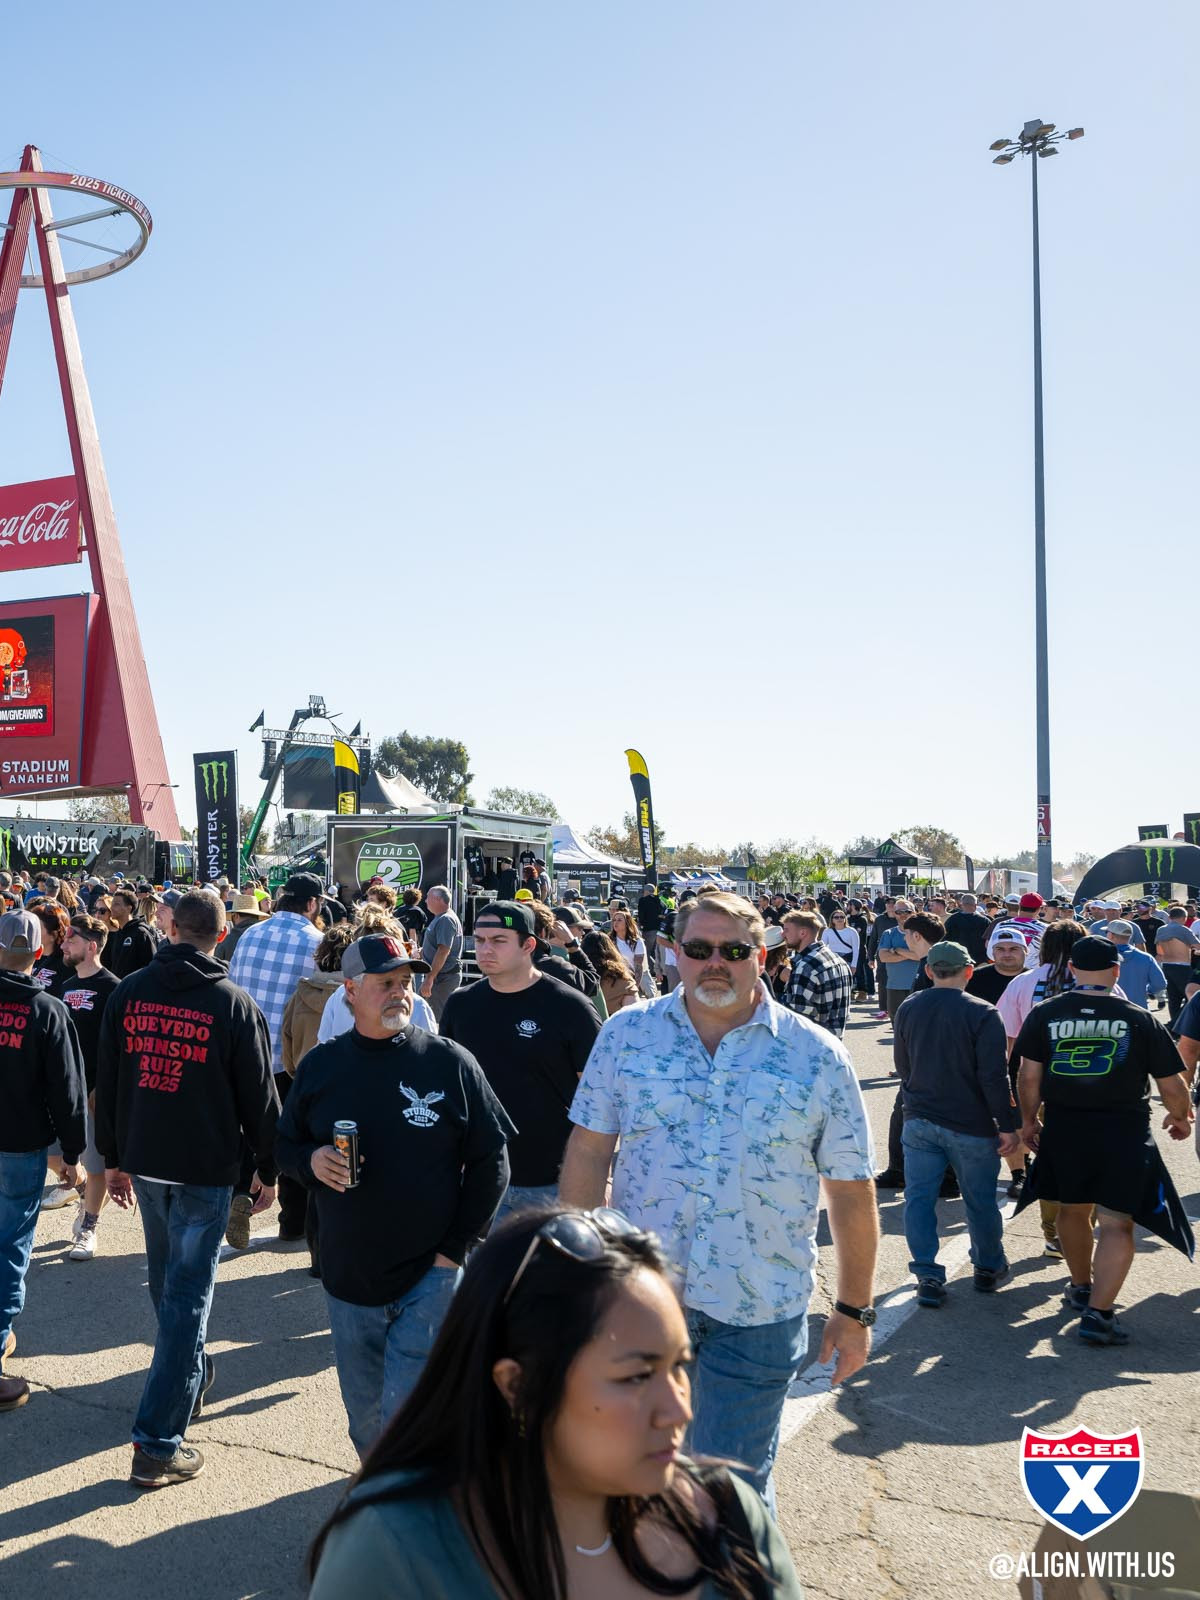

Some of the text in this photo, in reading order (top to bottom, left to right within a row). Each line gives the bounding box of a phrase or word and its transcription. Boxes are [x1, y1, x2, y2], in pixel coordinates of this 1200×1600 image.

[70, 174, 101, 190] 2025
[102, 182, 134, 206] TICKETS
[2, 759, 69, 773] STADIUM
[8, 774, 69, 784] ANAHEIM
[17, 832, 100, 856] MONSTER
[207, 809, 222, 878] ONSTER
[375, 847, 403, 856] ROAD
[31, 858, 88, 866] ENERGY
[376, 859, 401, 890] 2
[140, 1002, 214, 1025] SUPERCROSS
[123, 1015, 210, 1042] QUEVEDO
[1048, 1020, 1128, 1040] TOMAC
[125, 1036, 208, 1063] JOHNSON
[1051, 1037, 1118, 1076] 3
[139, 1054, 183, 1077] RUIZ
[138, 1071, 181, 1092] 2025
[402, 1107, 440, 1122] STURGIS
